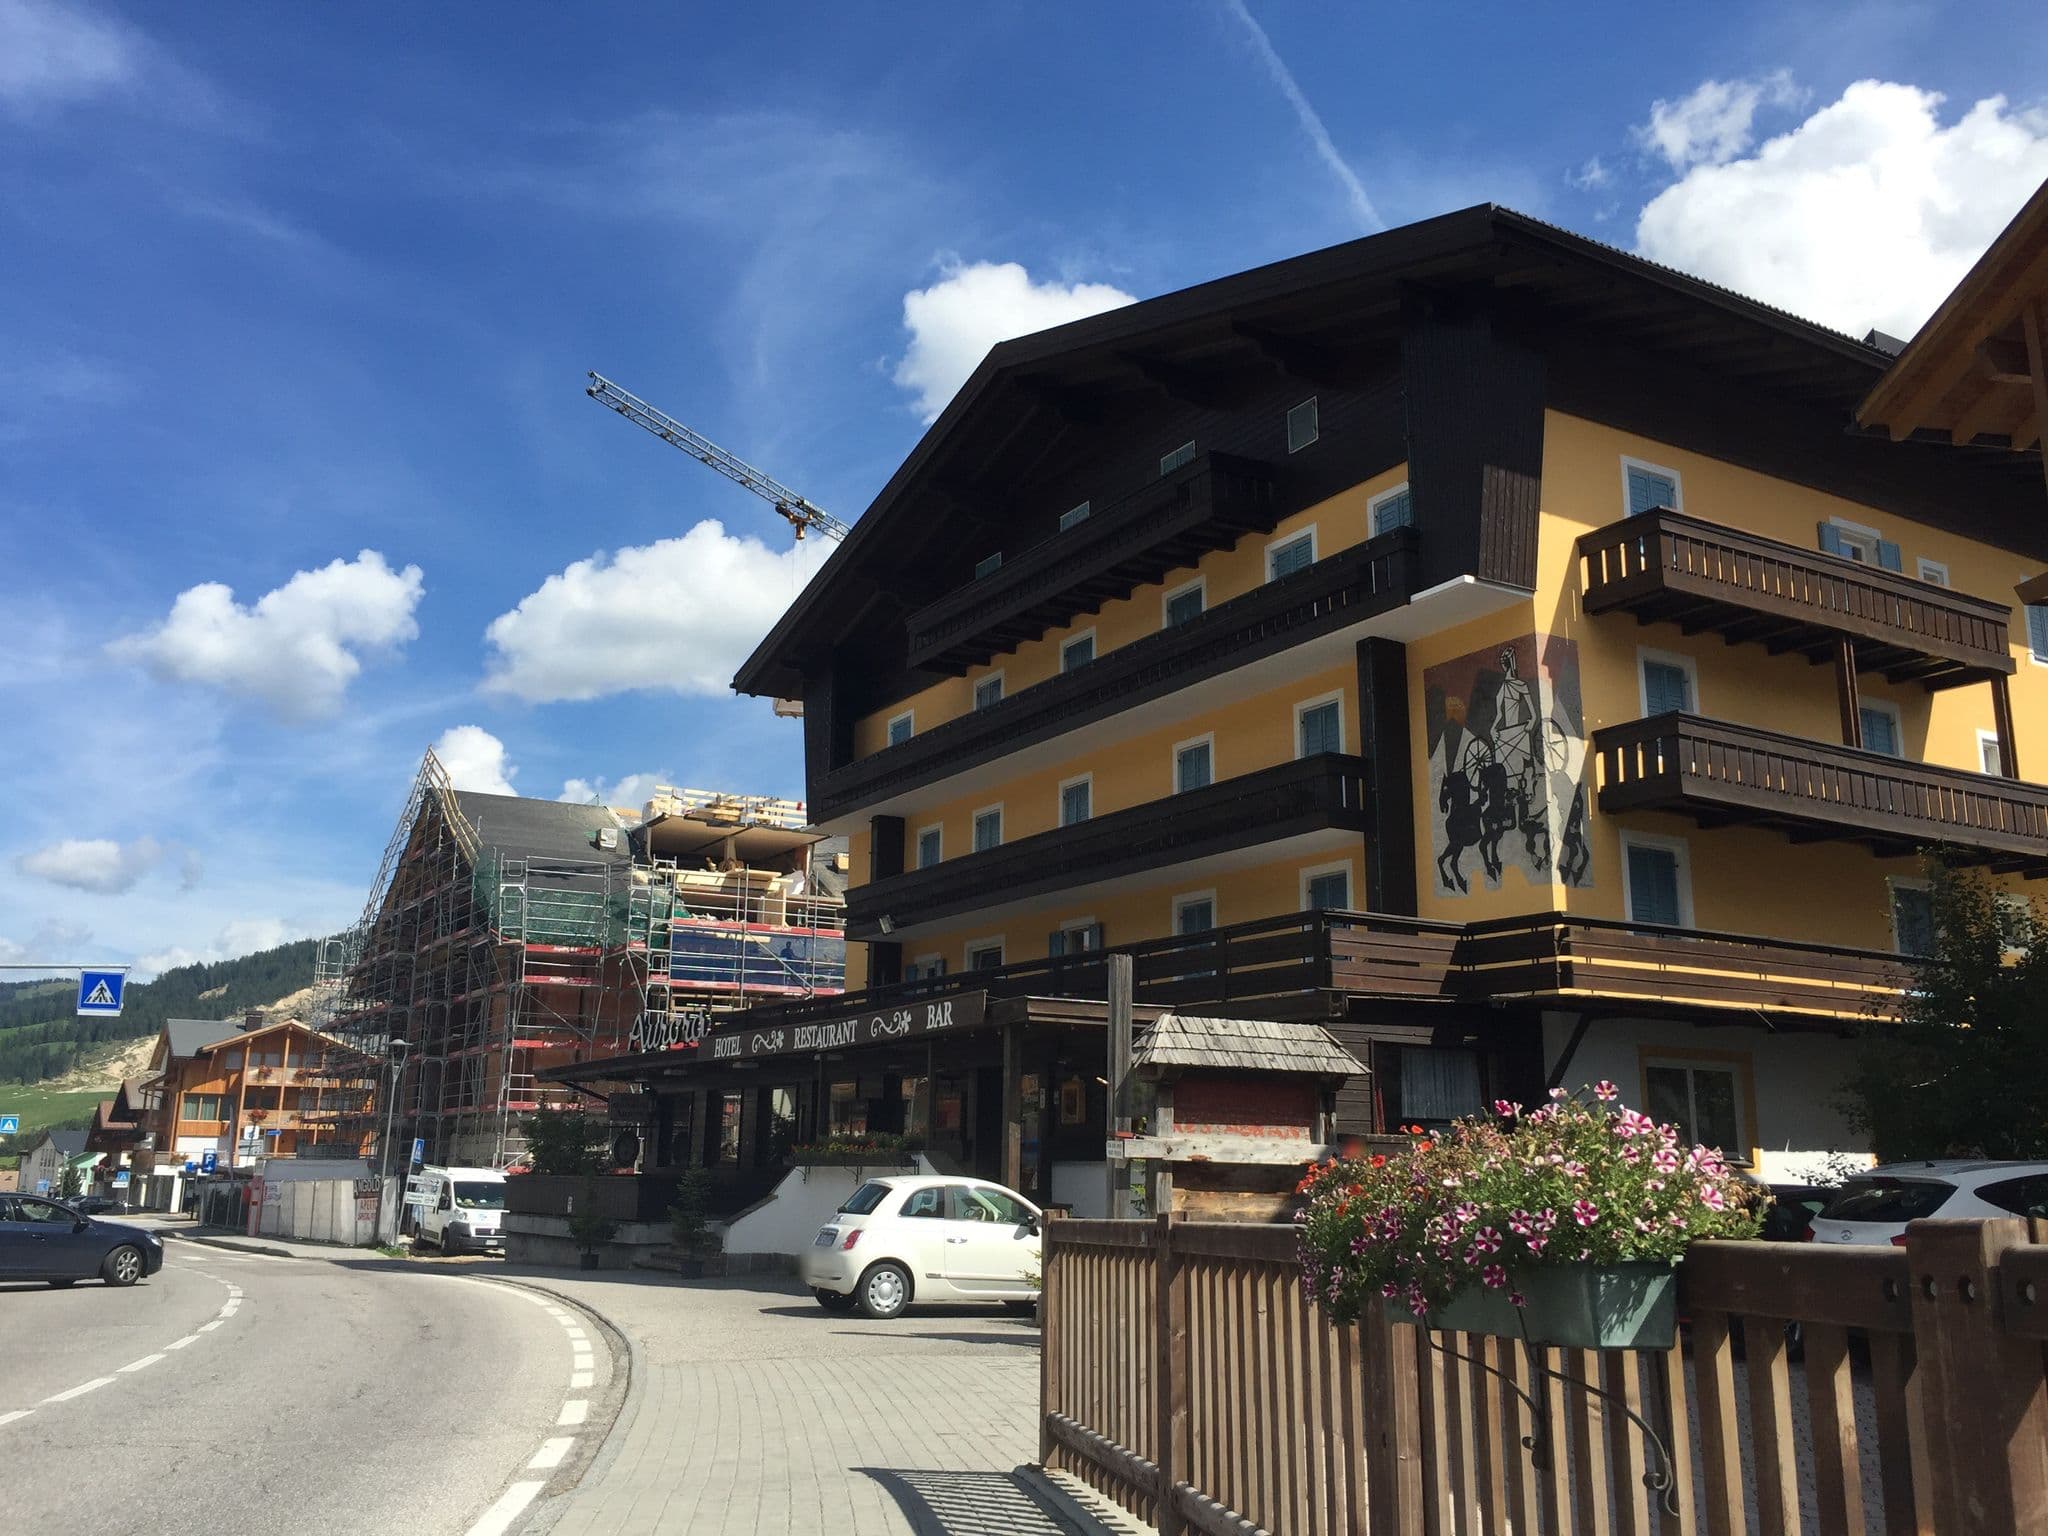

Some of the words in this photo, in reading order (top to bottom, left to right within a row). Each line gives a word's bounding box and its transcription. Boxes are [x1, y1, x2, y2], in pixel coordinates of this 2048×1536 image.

[628, 1010, 711, 1053] Aurora
[714, 1035, 742, 1058] HOTEL
[793, 1019, 858, 1050] RESTAURANT
[926, 1001, 954, 1030] BAR
